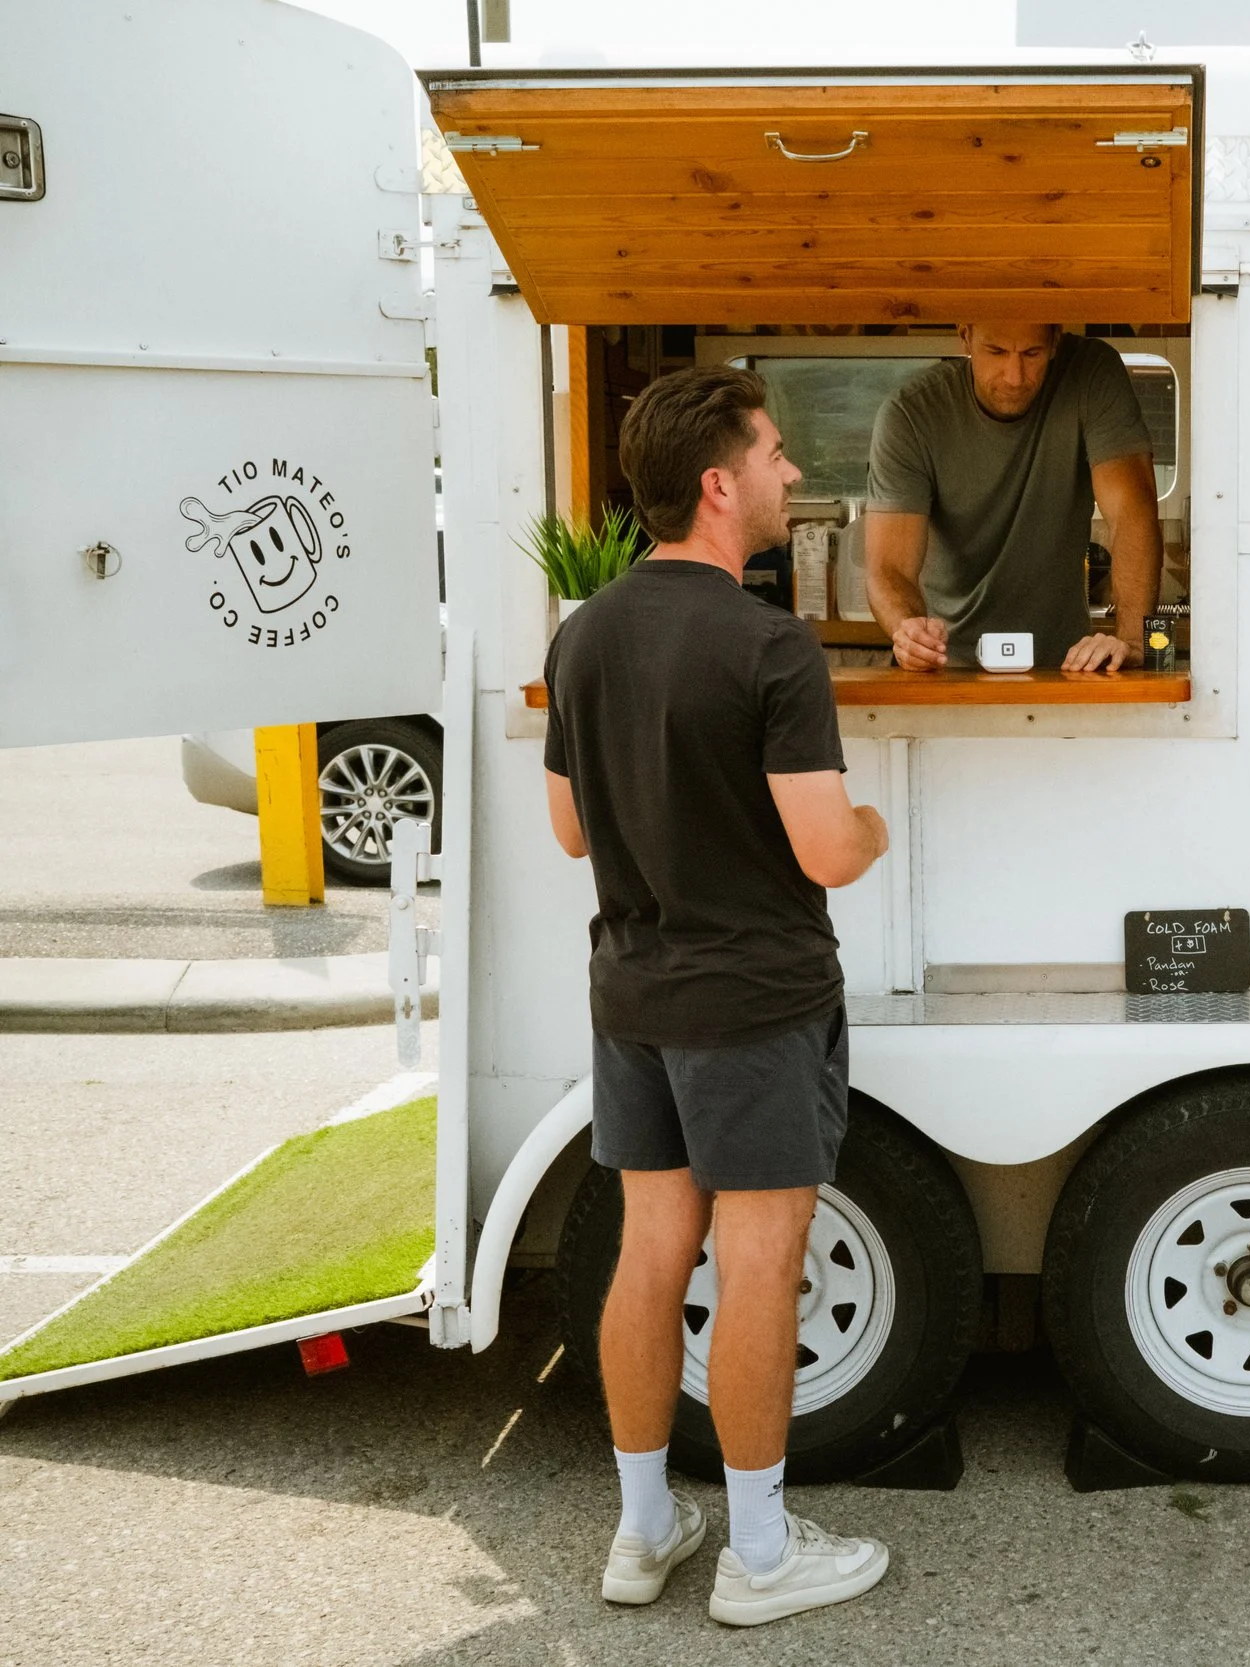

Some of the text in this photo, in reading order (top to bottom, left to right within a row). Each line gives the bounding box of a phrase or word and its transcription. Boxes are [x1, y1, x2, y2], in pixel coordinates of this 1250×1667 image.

[218, 458, 351, 559] TIO MATEO'S
[209, 580, 339, 648] COFFEE CO.
[1145, 619, 1166, 630] TIPS
[1146, 921, 1232, 934] COLD FOAM
